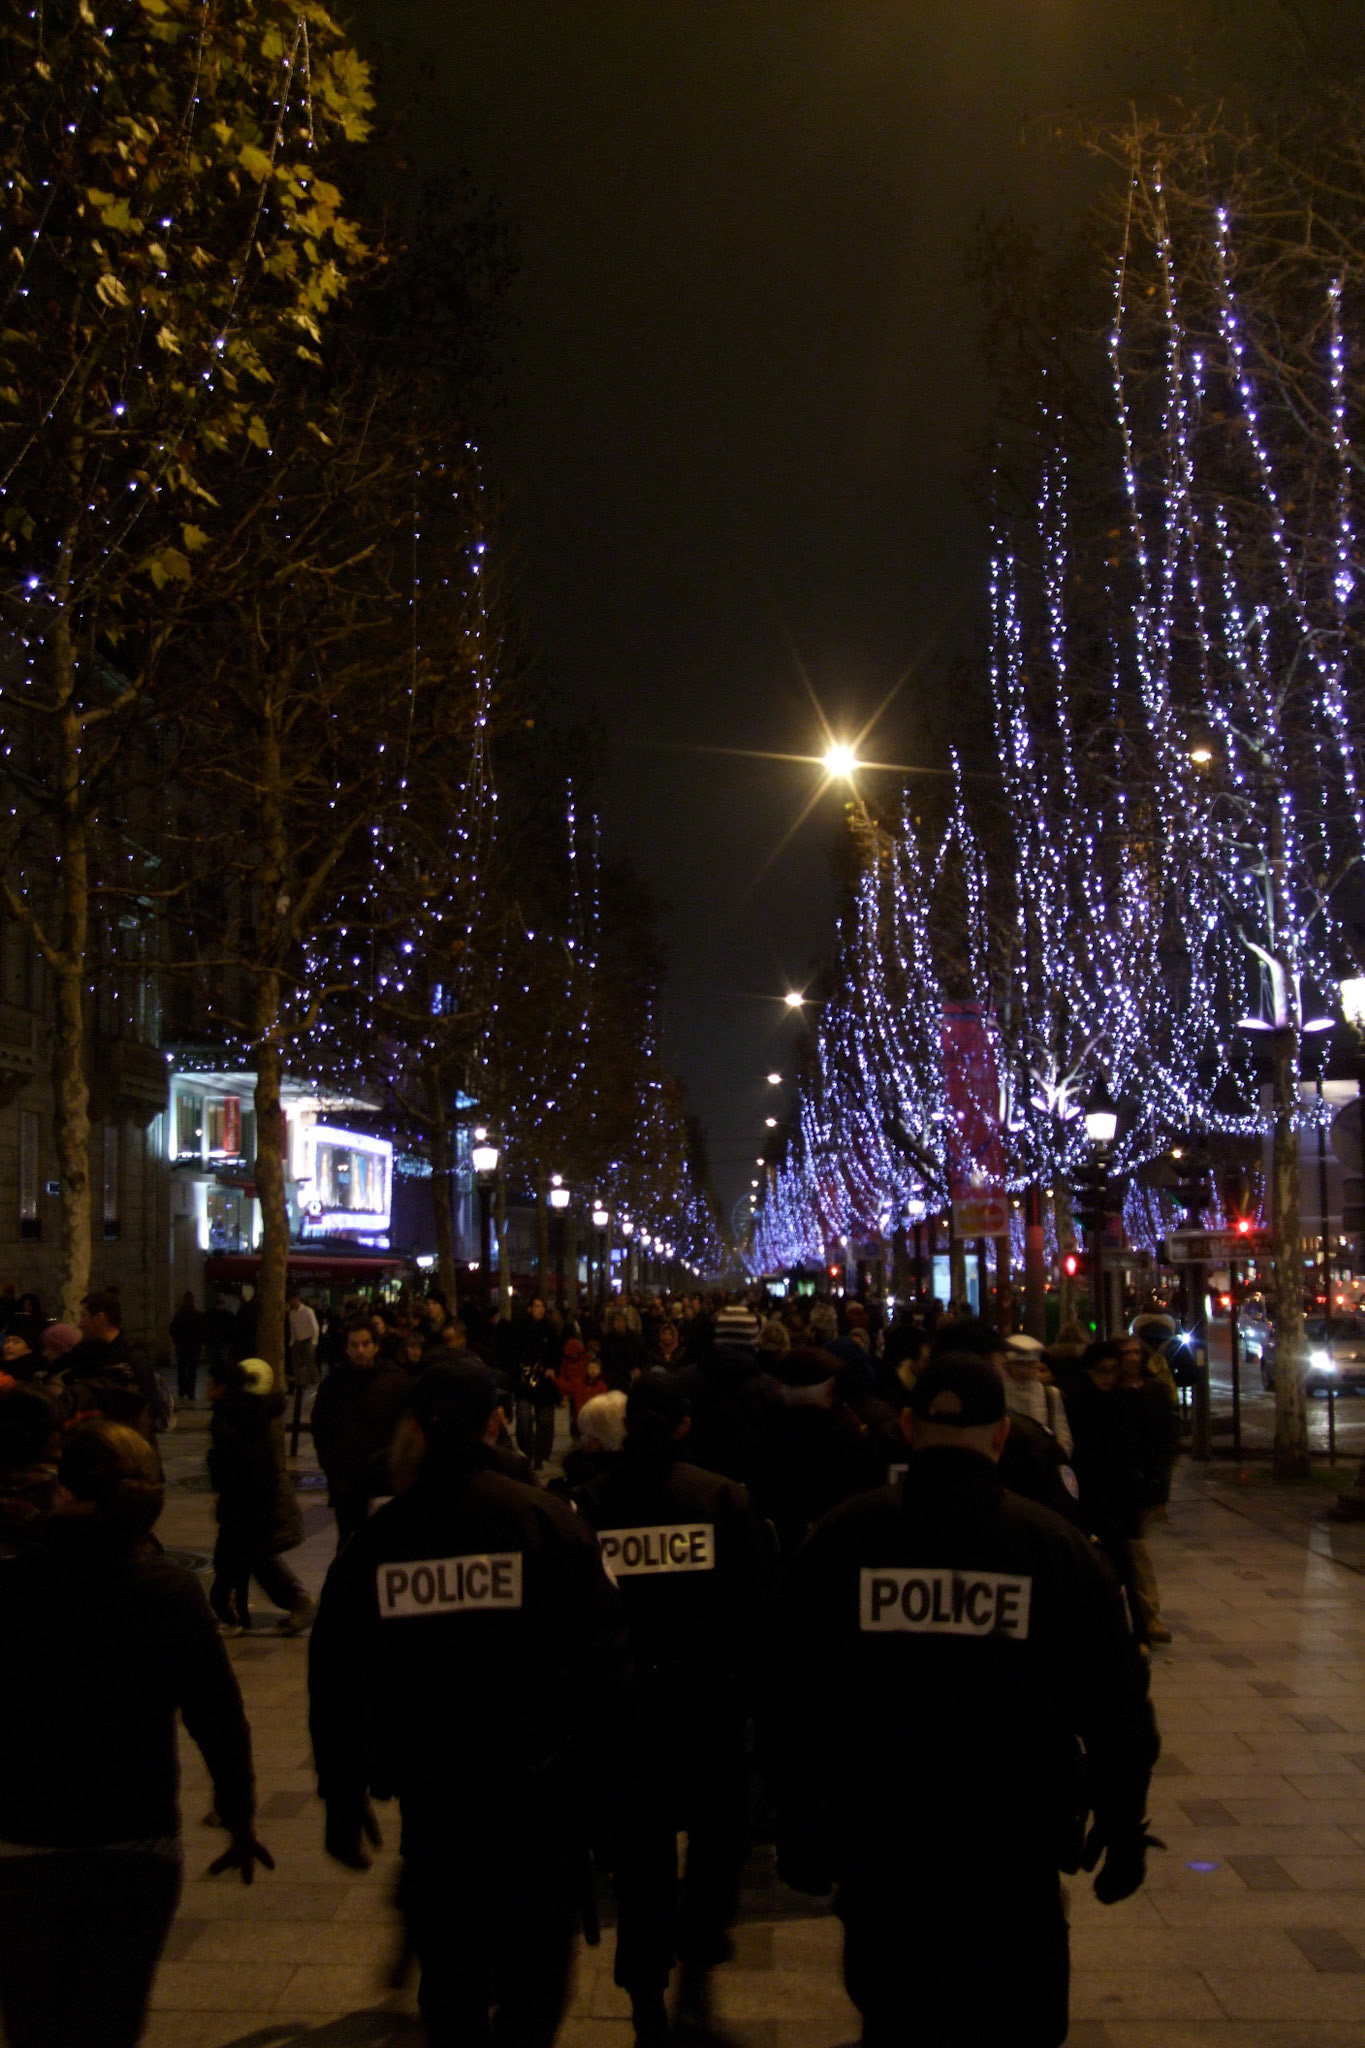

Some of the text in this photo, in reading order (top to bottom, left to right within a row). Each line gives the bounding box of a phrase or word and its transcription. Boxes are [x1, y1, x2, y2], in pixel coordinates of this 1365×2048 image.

[600, 1530, 706, 1567] POLICE
[386, 1560, 514, 1608] POLICE
[871, 1577, 1022, 1629] POLICE
